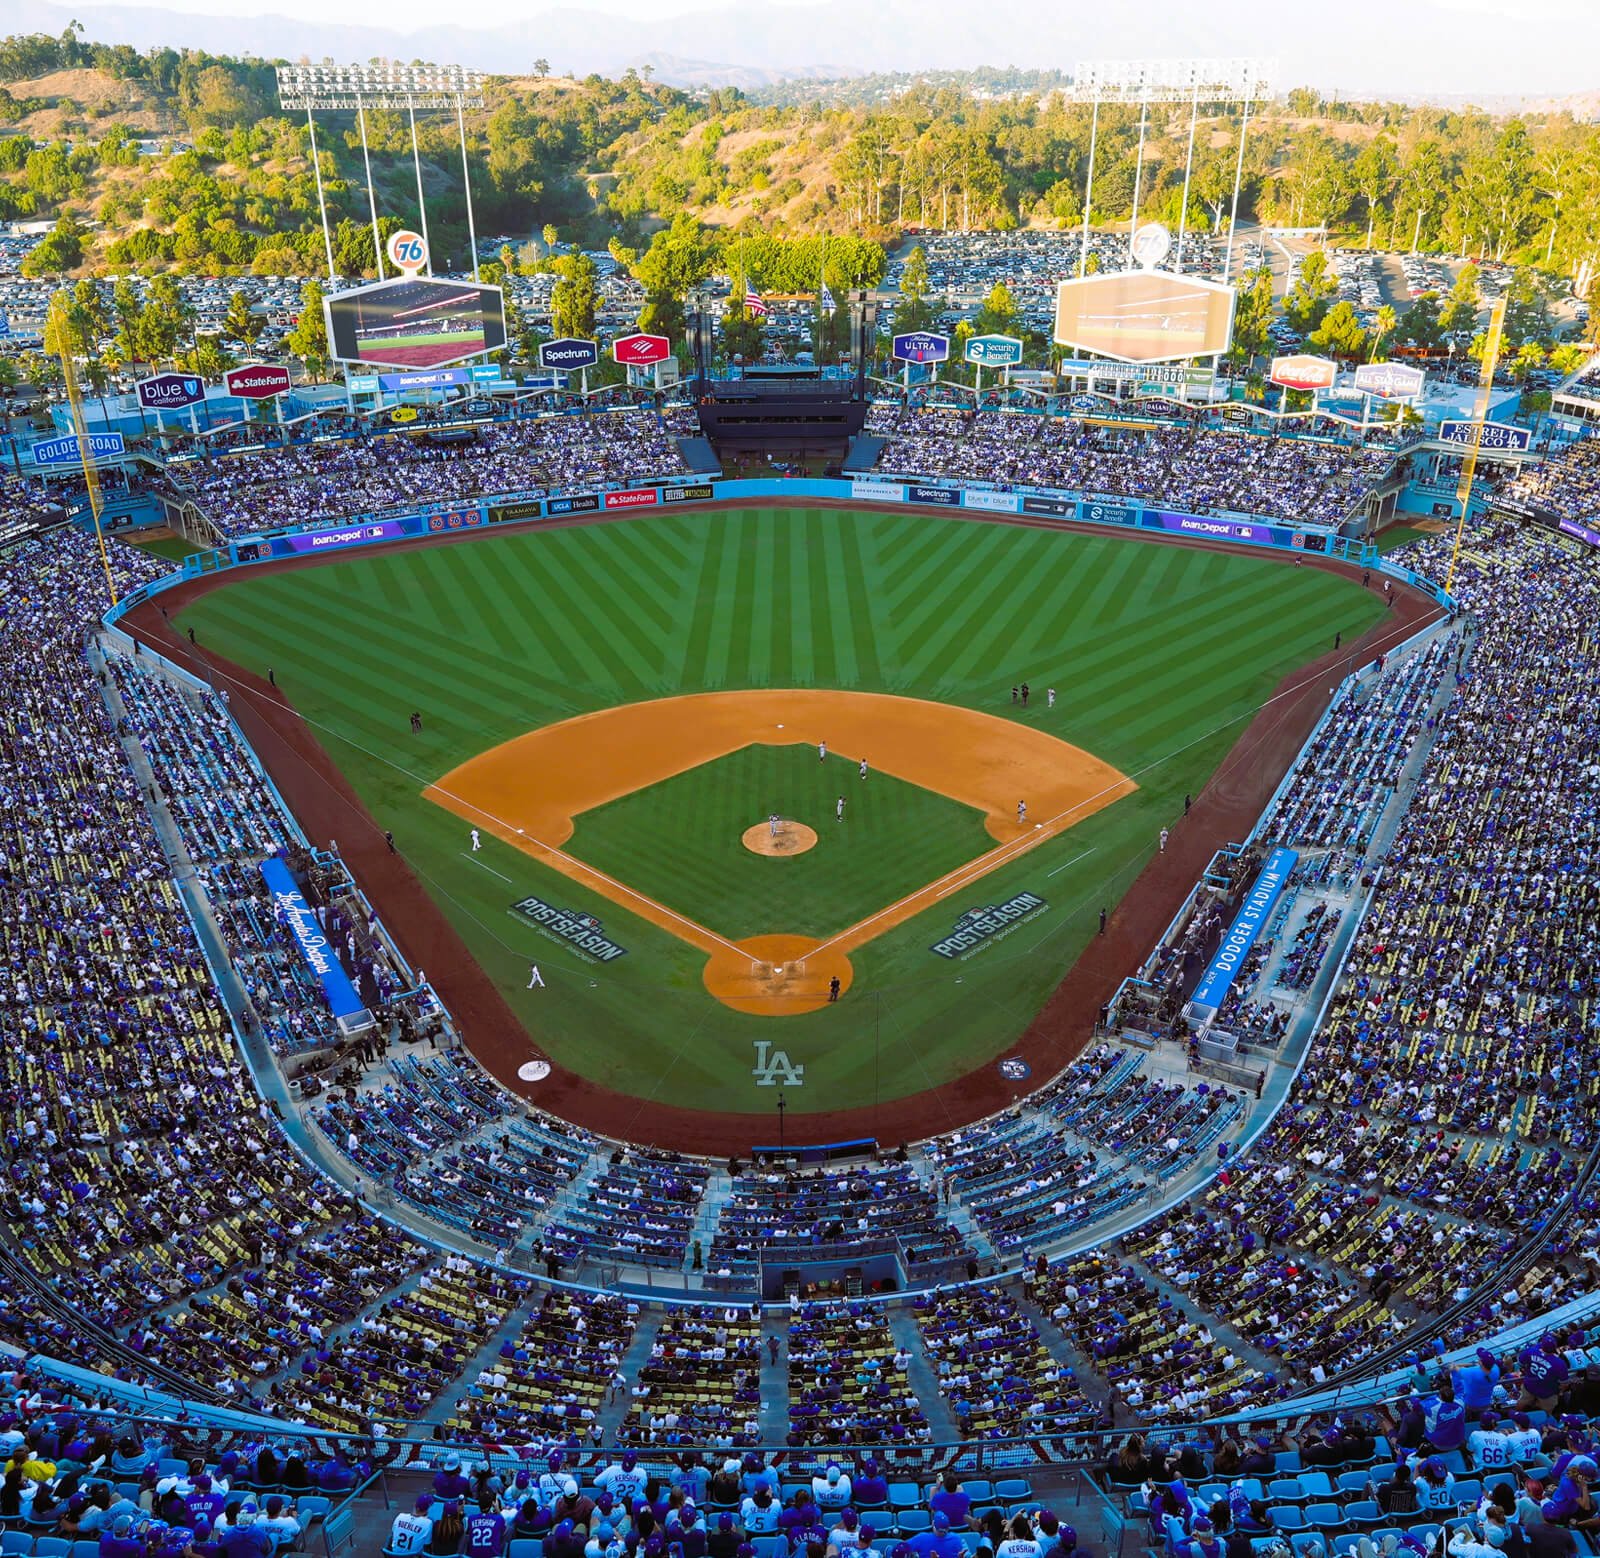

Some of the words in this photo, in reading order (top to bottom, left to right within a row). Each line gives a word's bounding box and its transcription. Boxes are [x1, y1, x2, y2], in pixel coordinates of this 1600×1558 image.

[397, 239, 423, 262] 76
[1139, 233, 1163, 255] 76
[904, 341, 936, 351] ULTRA
[986, 342, 1017, 354] Security
[545, 349, 590, 362] Spectrum
[986, 351, 1012, 361] Benefit
[144, 383, 182, 399] blue
[153, 395, 188, 406] california
[87, 438, 120, 451] ROAD
[1447, 432, 1504, 447] JALISCO
[916, 488, 950, 498] Spectrum
[572, 499, 595, 509] Health
[468, 513, 478, 522] 76
[1103, 507, 1128, 518] Security
[1103, 514, 1124, 522] Benefit
[432, 518, 442, 528] 76
[450, 516, 460, 525] 76
[1293, 535, 1303, 546] 76
[261, 544, 271, 556] 76
[275, 890, 303, 911] Los
[286, 907, 314, 940] Angeles
[514, 897, 623, 960] POSTSEASON
[932, 892, 1043, 958] POSTSEASON
[1215, 922, 1254, 972] DODGER
[1244, 872, 1281, 919] STADIUM
[301, 935, 333, 974] Dodgers
[752, 1040, 804, 1086] LA
[1529, 1362, 1548, 1380] 22
[1484, 1438, 1501, 1446] PUIG
[1482, 1447, 1503, 1464] 66
[614, 1474, 640, 1483] KERSHAW
[615, 1483, 636, 1499] 22
[1429, 1490, 1448, 1506] 50
[189, 1501, 214, 1513] TAYLOR
[398, 1520, 423, 1534] BUEHLER
[471, 1518, 497, 1528] KERSHAW
[754, 1516, 765, 1530] 5
[397, 1532, 414, 1551] 21
[472, 1528, 493, 1547] 22
[1007, 1544, 1036, 1554] KERSHAW
